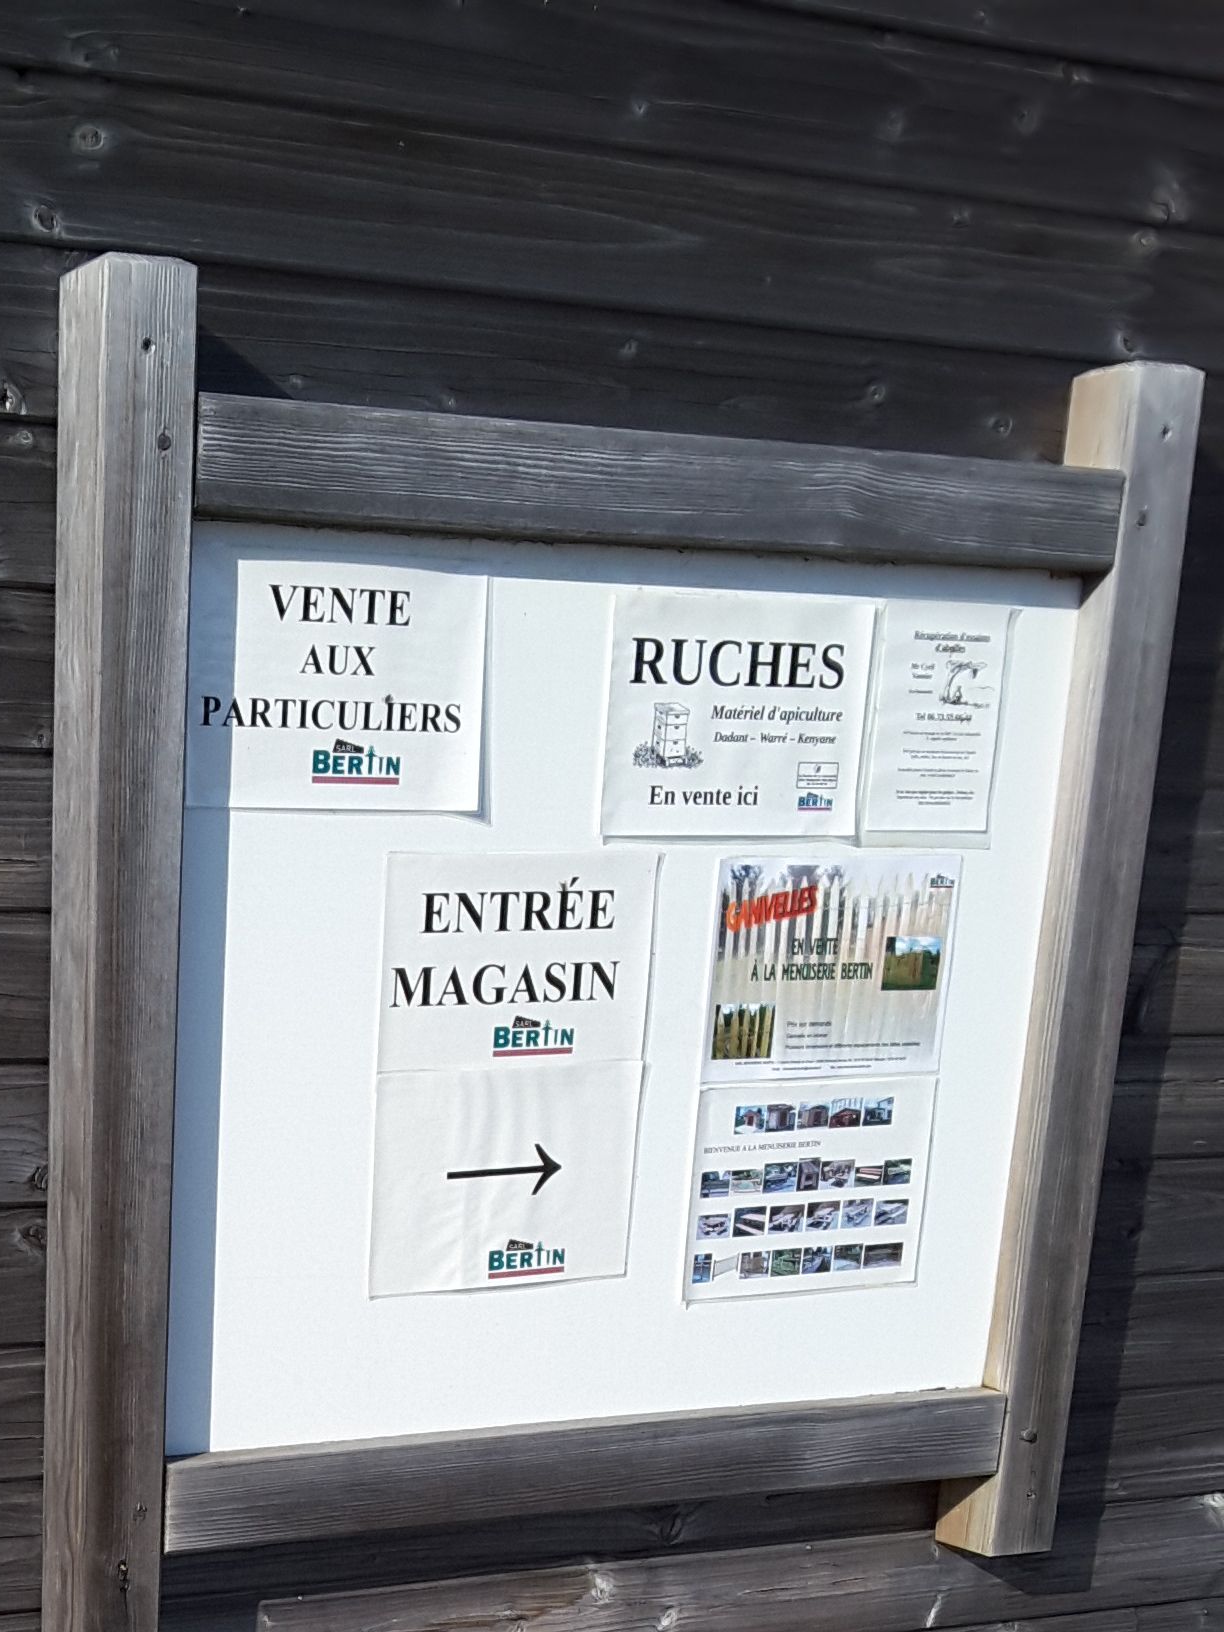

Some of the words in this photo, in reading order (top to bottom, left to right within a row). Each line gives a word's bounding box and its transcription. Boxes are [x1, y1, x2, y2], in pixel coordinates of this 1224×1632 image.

[269, 584, 411, 627] VENTE
[299, 644, 376, 676] AUX
[629, 637, 845, 690] RUCHES
[200, 695, 462, 733] PARTICULIERS
[711, 705, 765, 720] Matériel
[767, 706, 843, 725] d'apiculture
[713, 732, 749, 743] Dadant
[760, 733, 788, 743] Warré
[648, 785, 676, 806] En
[682, 788, 731, 806] vente
[737, 785, 758, 806] ici
[420, 877, 616, 934] ENTRÉE
[792, 938, 804, 955] EN
[389, 960, 620, 1008] MAGASIN
[764, 963, 776, 981] LA
[841, 962, 873, 979] BERTIN
